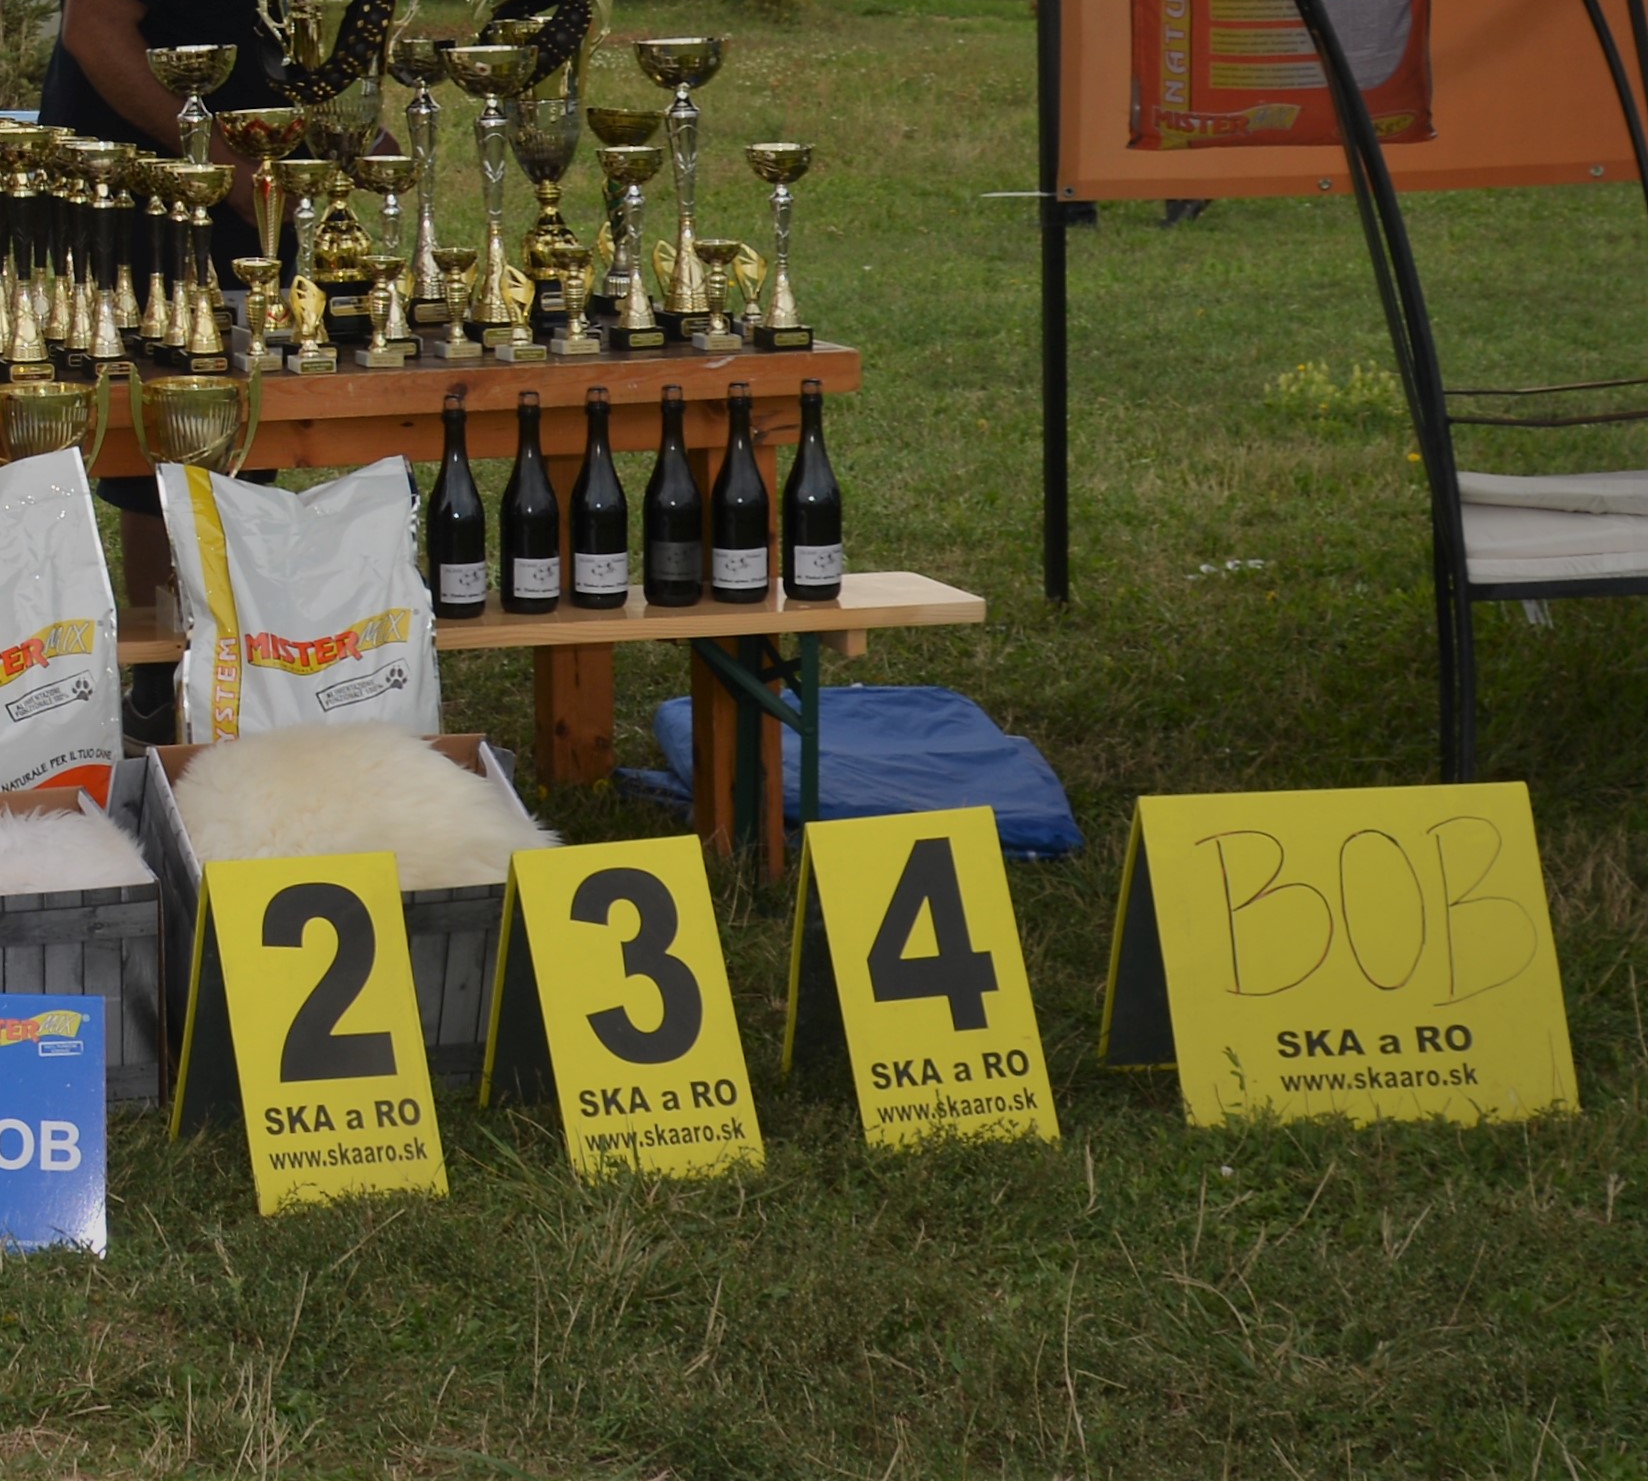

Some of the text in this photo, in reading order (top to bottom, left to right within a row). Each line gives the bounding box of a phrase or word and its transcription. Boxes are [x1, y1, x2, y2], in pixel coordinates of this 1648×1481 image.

[244, 630, 363, 668] MISTER
[1193, 815, 1539, 1007] BOB
[865, 836, 999, 1034] 4
[261, 881, 398, 1085] 2
[569, 866, 703, 1066] 3
[39, 1013, 76, 1034] MIX
[1275, 1023, 1474, 1060] SKA a RO
[870, 1048, 1031, 1091] SKA a RO
[1279, 1060, 1479, 1093] www.skaaro.sk
[264, 1096, 422, 1136] SKA a RO
[578, 1077, 739, 1118] SKA a RO
[876, 1087, 1039, 1126] www.skaaro.sk
[268, 1136, 428, 1171] www.skaaro.sk
[584, 1118, 747, 1154] www.skaaro.sk
